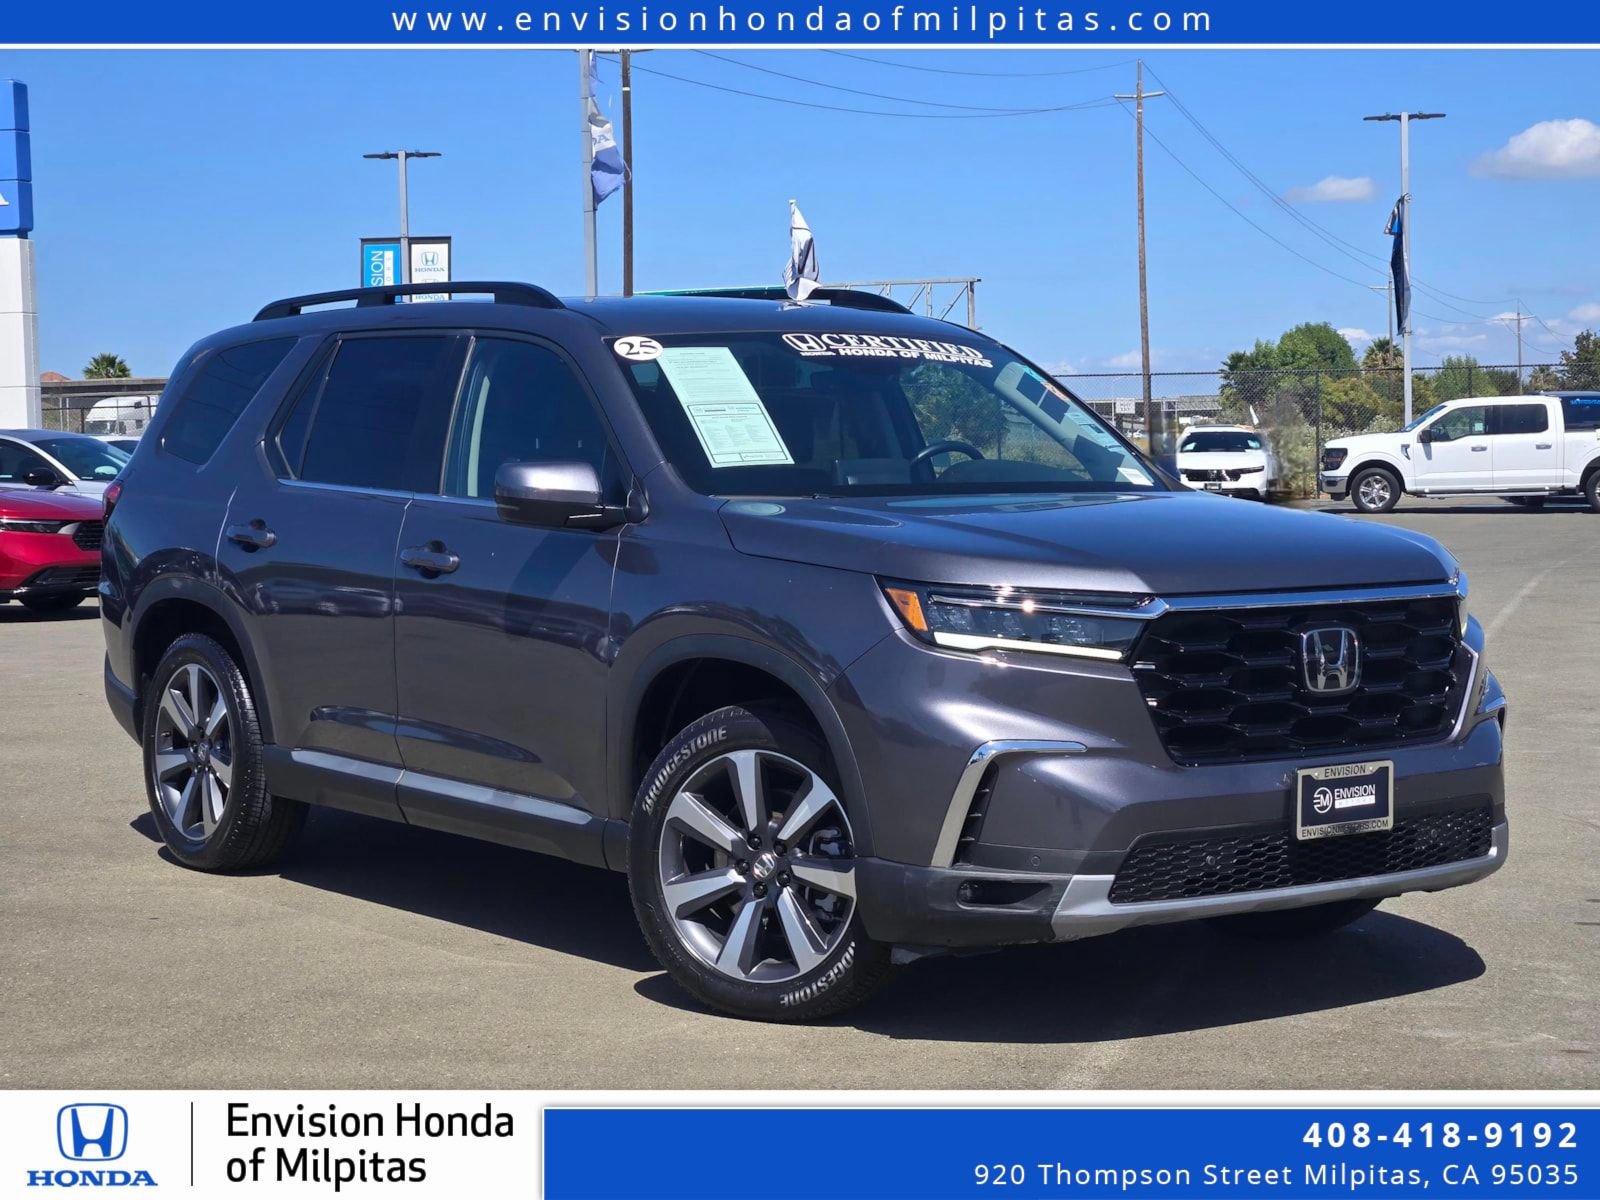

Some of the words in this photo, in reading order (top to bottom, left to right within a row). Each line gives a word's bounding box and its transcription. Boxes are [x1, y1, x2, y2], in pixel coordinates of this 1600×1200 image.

[618, 340, 659, 356] 25
[820, 333, 984, 359] CERTIFIED
[838, 347, 899, 358] HONDA
[900, 351, 921, 359] OF
[924, 351, 994, 368] MILPITAS
[642, 725, 728, 816] BRIDGESTONE
[1324, 764, 1366, 778] ENVISION
[1334, 784, 1376, 800] ENVISION
